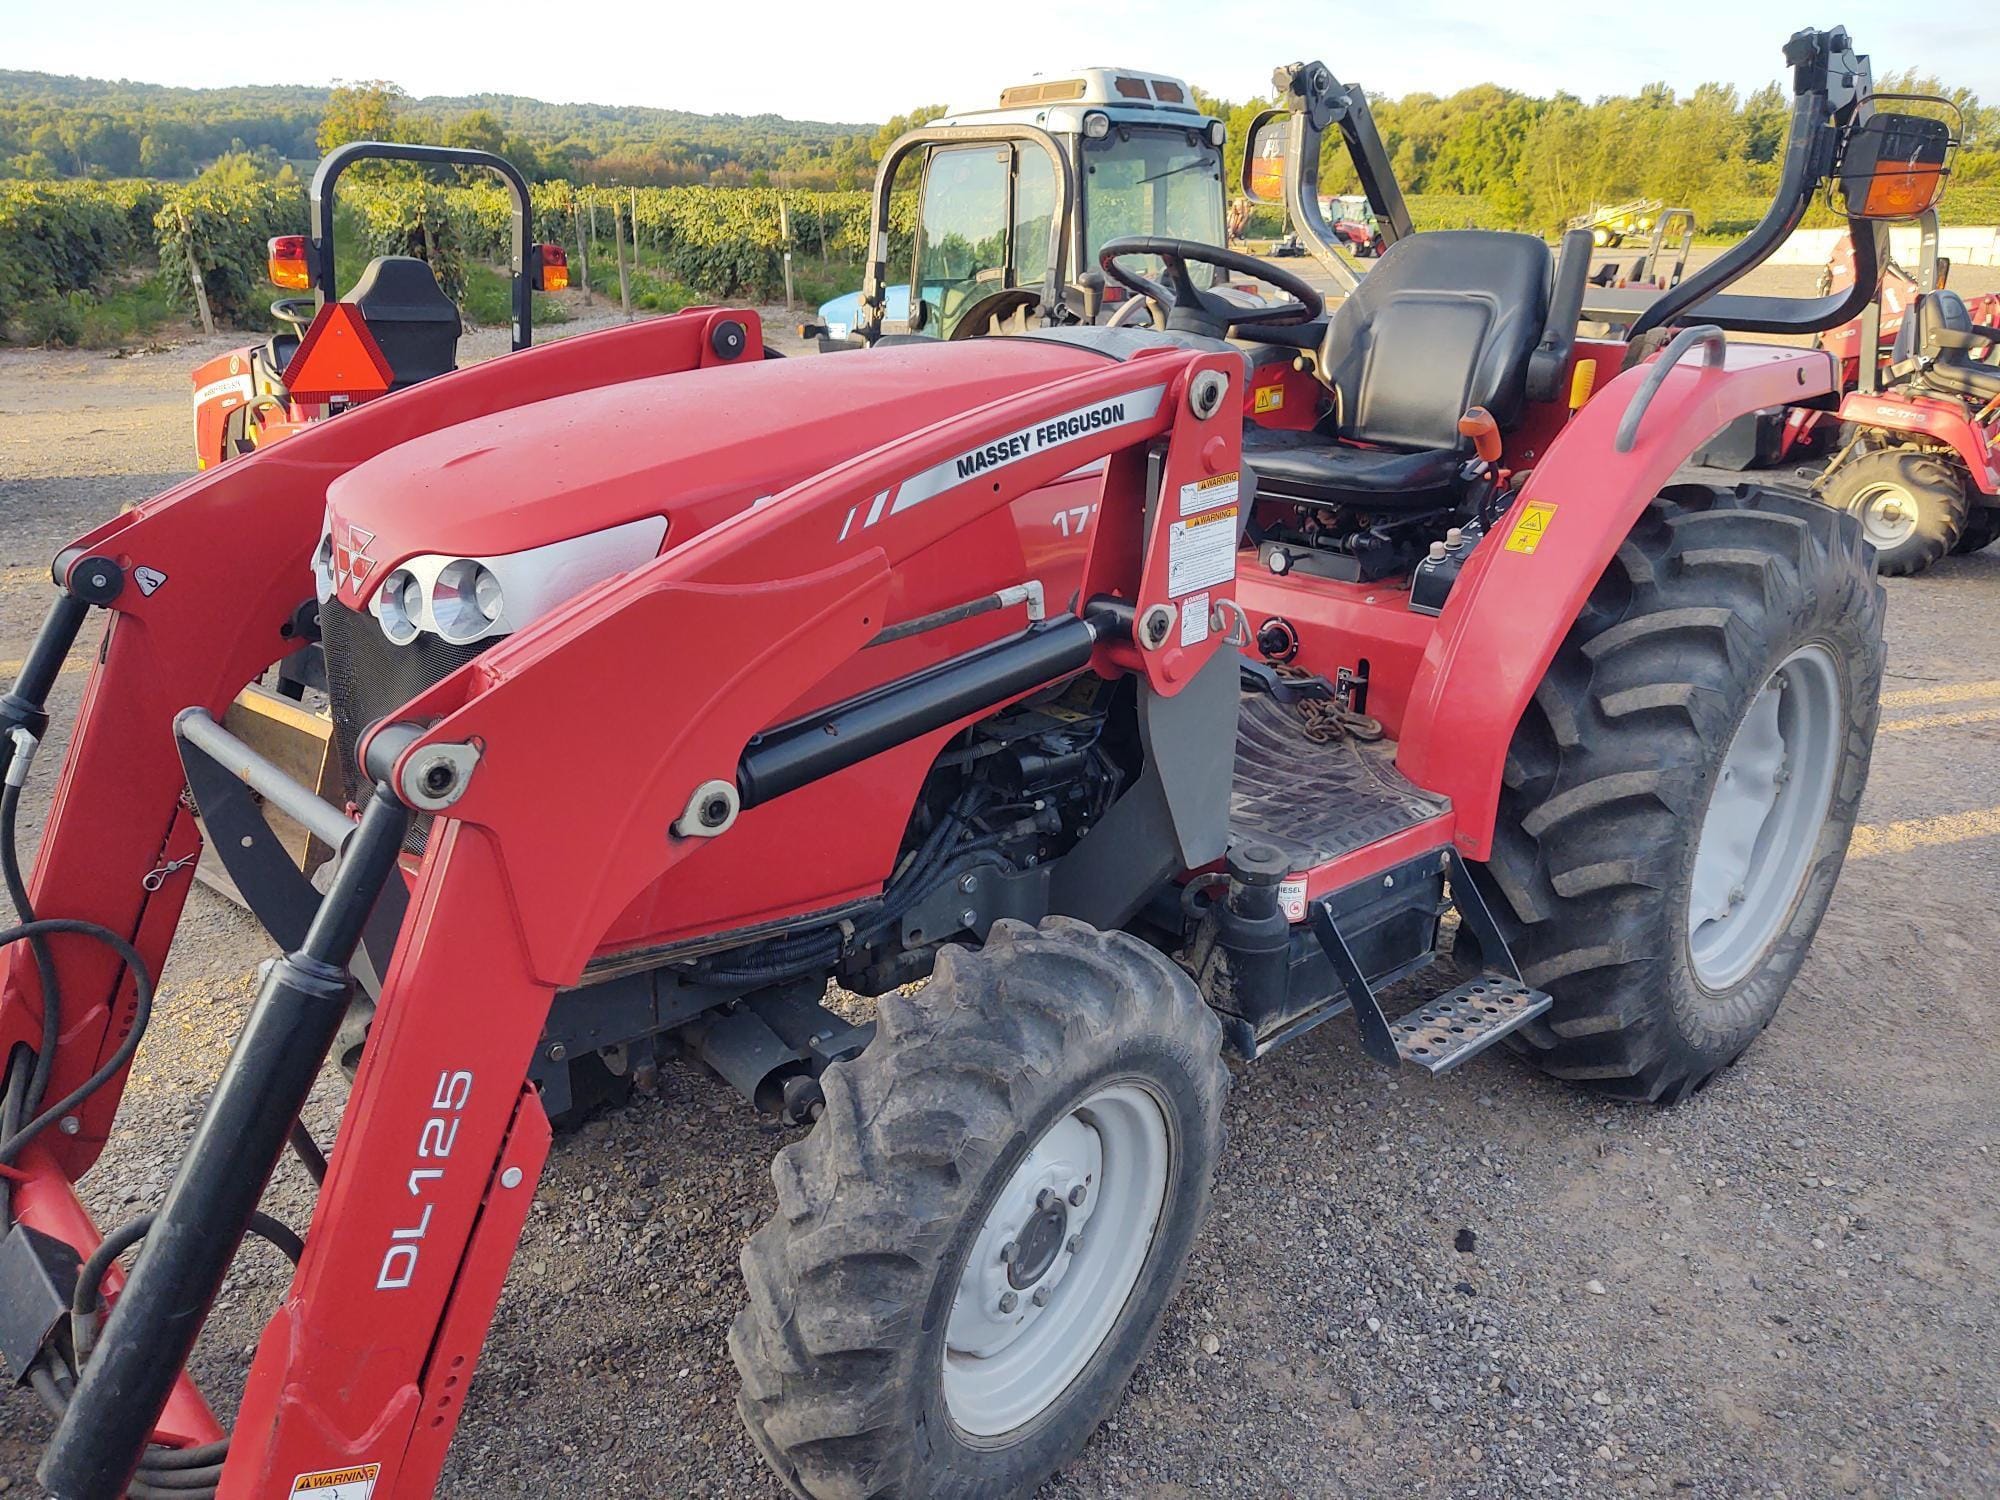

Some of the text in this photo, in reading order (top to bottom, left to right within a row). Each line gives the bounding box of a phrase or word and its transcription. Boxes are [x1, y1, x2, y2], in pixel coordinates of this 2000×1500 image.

[956, 403, 1125, 479] MASSEY FERGUSON
[1207, 473, 1237, 486] WARNING
[1052, 503, 1098, 537] 17
[1200, 509, 1231, 525] WARNING
[1280, 886, 1302, 894] IESEL
[375, 1070, 473, 1289] DL125
[313, 1469, 375, 1487] WARNING
